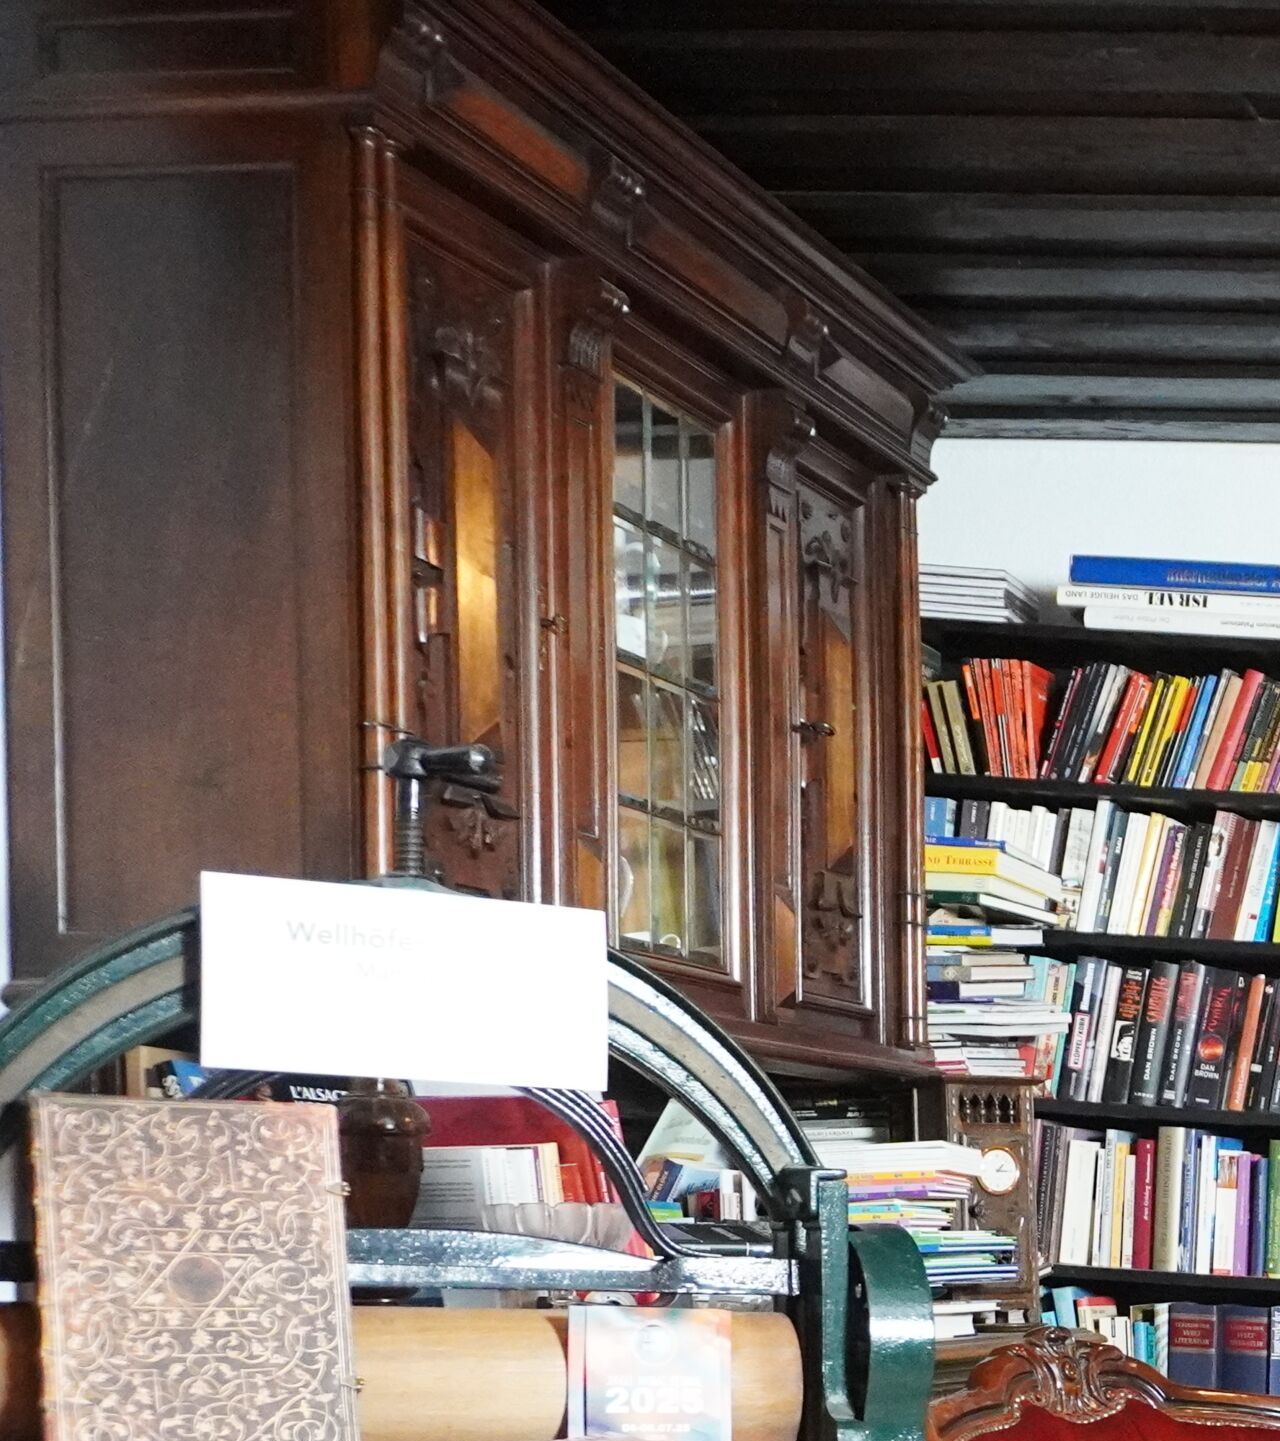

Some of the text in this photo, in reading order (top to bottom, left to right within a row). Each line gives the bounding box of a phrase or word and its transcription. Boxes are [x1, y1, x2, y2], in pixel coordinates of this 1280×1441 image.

[1064, 588, 1087, 600] LAND
[1144, 591, 1208, 609] ISRAEL
[1145, 1028, 1157, 1060] BROWN
[1172, 1028, 1183, 1060] BROWN
[1142, 1061, 1152, 1081] DAN
[1168, 1062, 1178, 1081] DAN
[1194, 1069, 1220, 1080] BROWN
[1200, 1063, 1215, 1072] DAN
[604, 1386, 705, 1414] 2025
